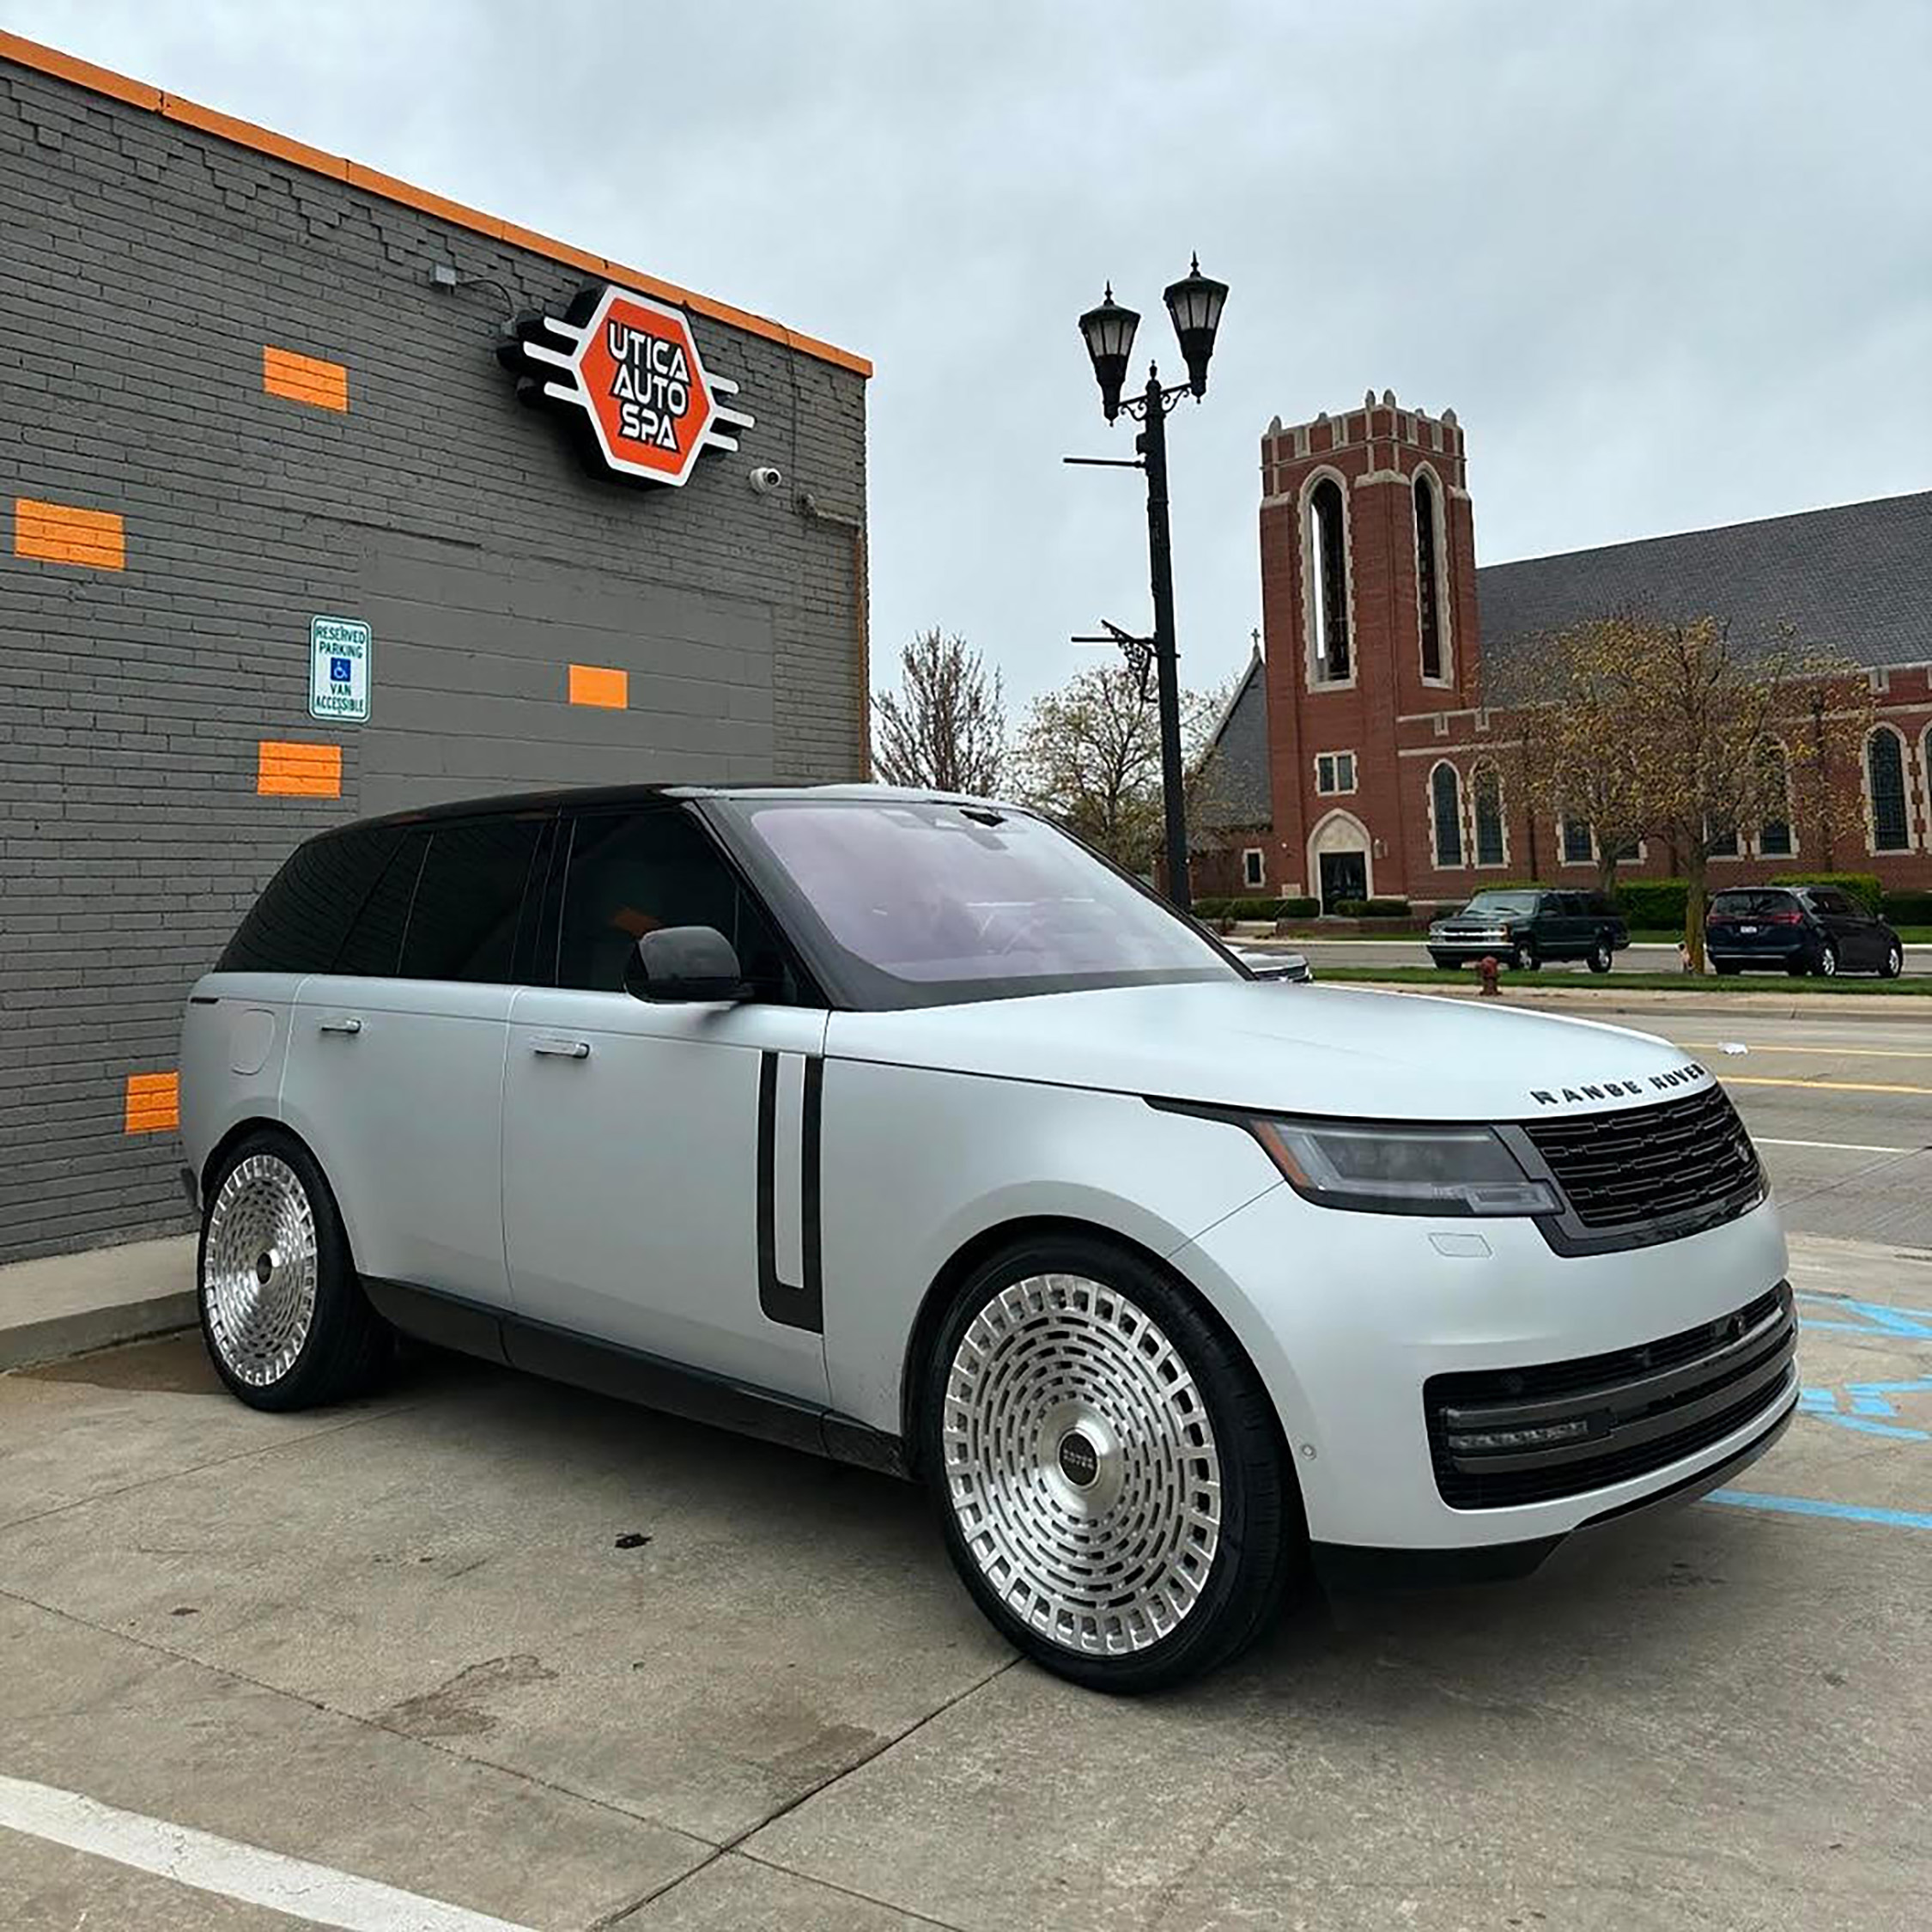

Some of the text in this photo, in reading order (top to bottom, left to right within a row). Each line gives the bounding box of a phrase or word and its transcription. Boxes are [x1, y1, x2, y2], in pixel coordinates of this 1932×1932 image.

[609, 323, 690, 382] UTICA
[613, 364, 687, 415] AUTO
[622, 404, 677, 450] SPA
[316, 626, 366, 644] RESERVED
[319, 641, 362, 659] PARKING
[316, 696, 364, 713] ACCESSIBLE
[330, 683, 351, 696] VAN
[1530, 1063, 1705, 1105] RANGE ROVER
